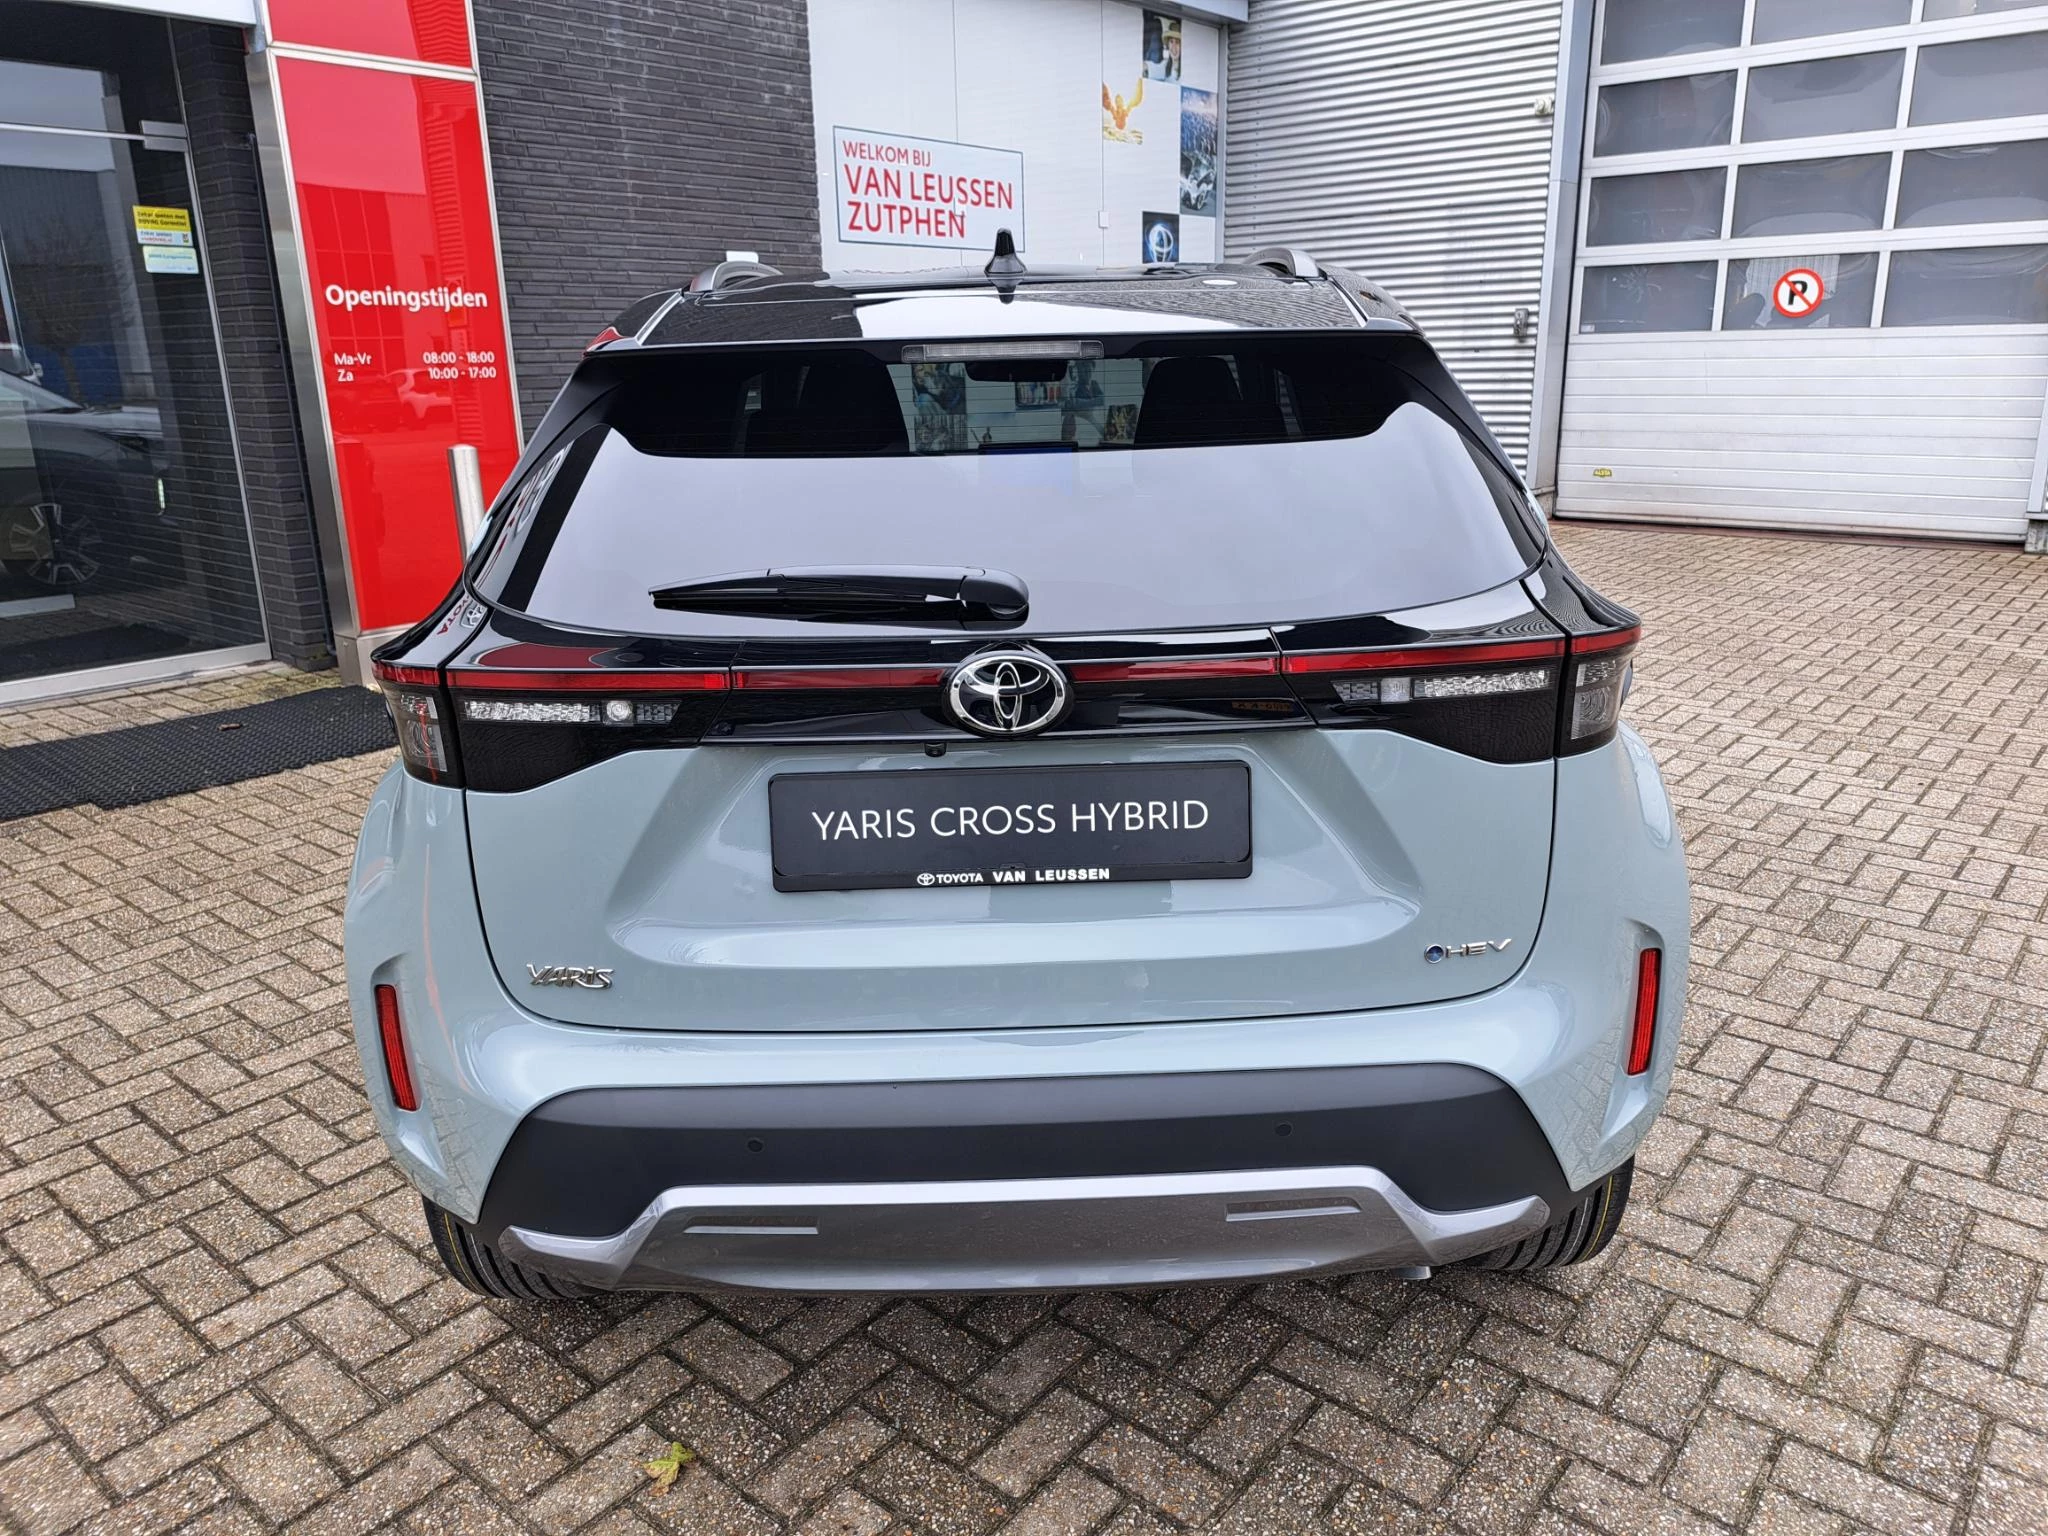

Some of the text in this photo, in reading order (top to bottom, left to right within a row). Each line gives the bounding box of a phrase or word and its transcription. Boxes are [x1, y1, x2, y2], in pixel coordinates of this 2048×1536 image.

[842, 140, 932, 167] WELKOM BIJ
[844, 163, 1013, 210] VAN LEUSSEN
[847, 200, 965, 238] ZUTPHEN
[325, 284, 488, 312] Openingstijden
[334, 352, 372, 366] Ma-Vr
[423, 351, 457, 365] 08:00
[466, 351, 495, 364] 18:00
[337, 369, 354, 382] Za
[428, 366, 459, 380] 10:00
[467, 366, 497, 379] 17:00
[811, 799, 1209, 841] YARIS CROSS HYBRID
[936, 868, 1110, 884] TOYOTA VAN LEUSSEN
[1445, 938, 1512, 958] HEV
